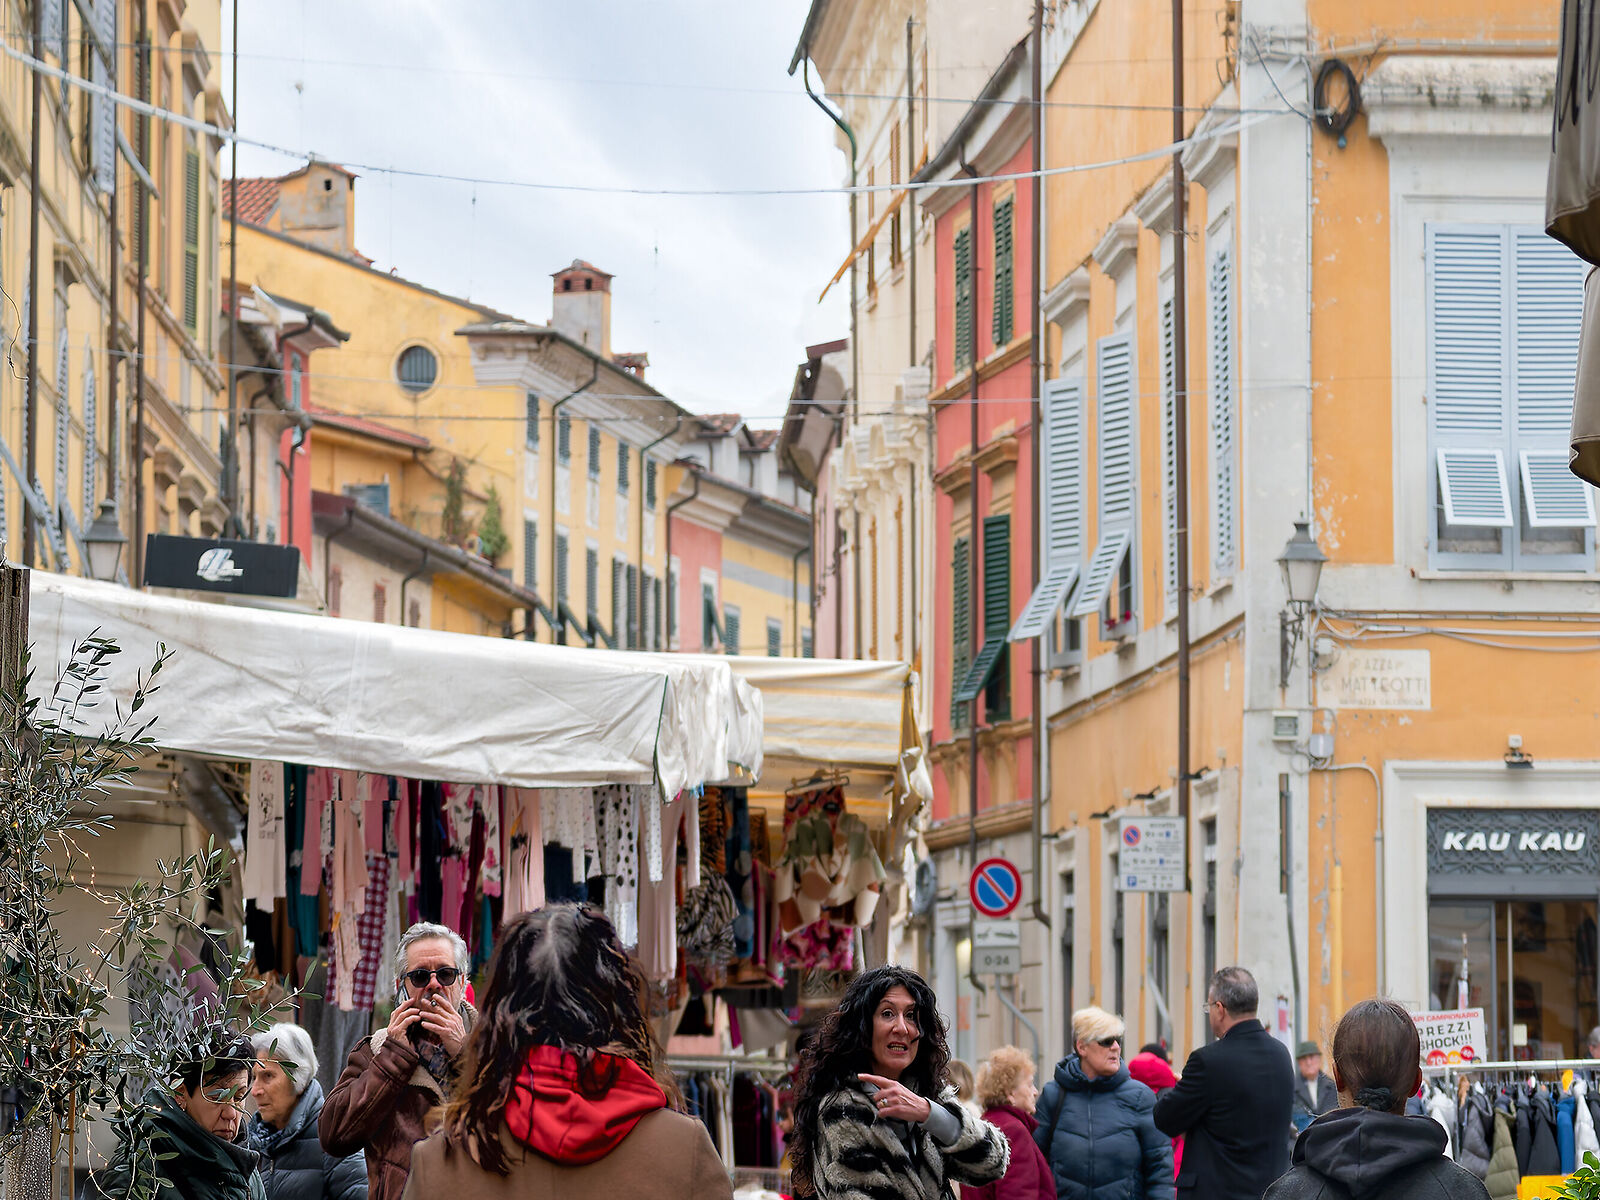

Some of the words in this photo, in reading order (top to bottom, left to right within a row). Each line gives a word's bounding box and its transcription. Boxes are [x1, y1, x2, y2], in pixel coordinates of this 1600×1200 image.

[1352, 657, 1394, 671] PAZZA
[1442, 831, 1511, 851] KAU
[1518, 831, 1586, 851] KAU
[1426, 1011, 1479, 1022] CAMPIONARIO
[1416, 1020, 1472, 1037] PREZZI
